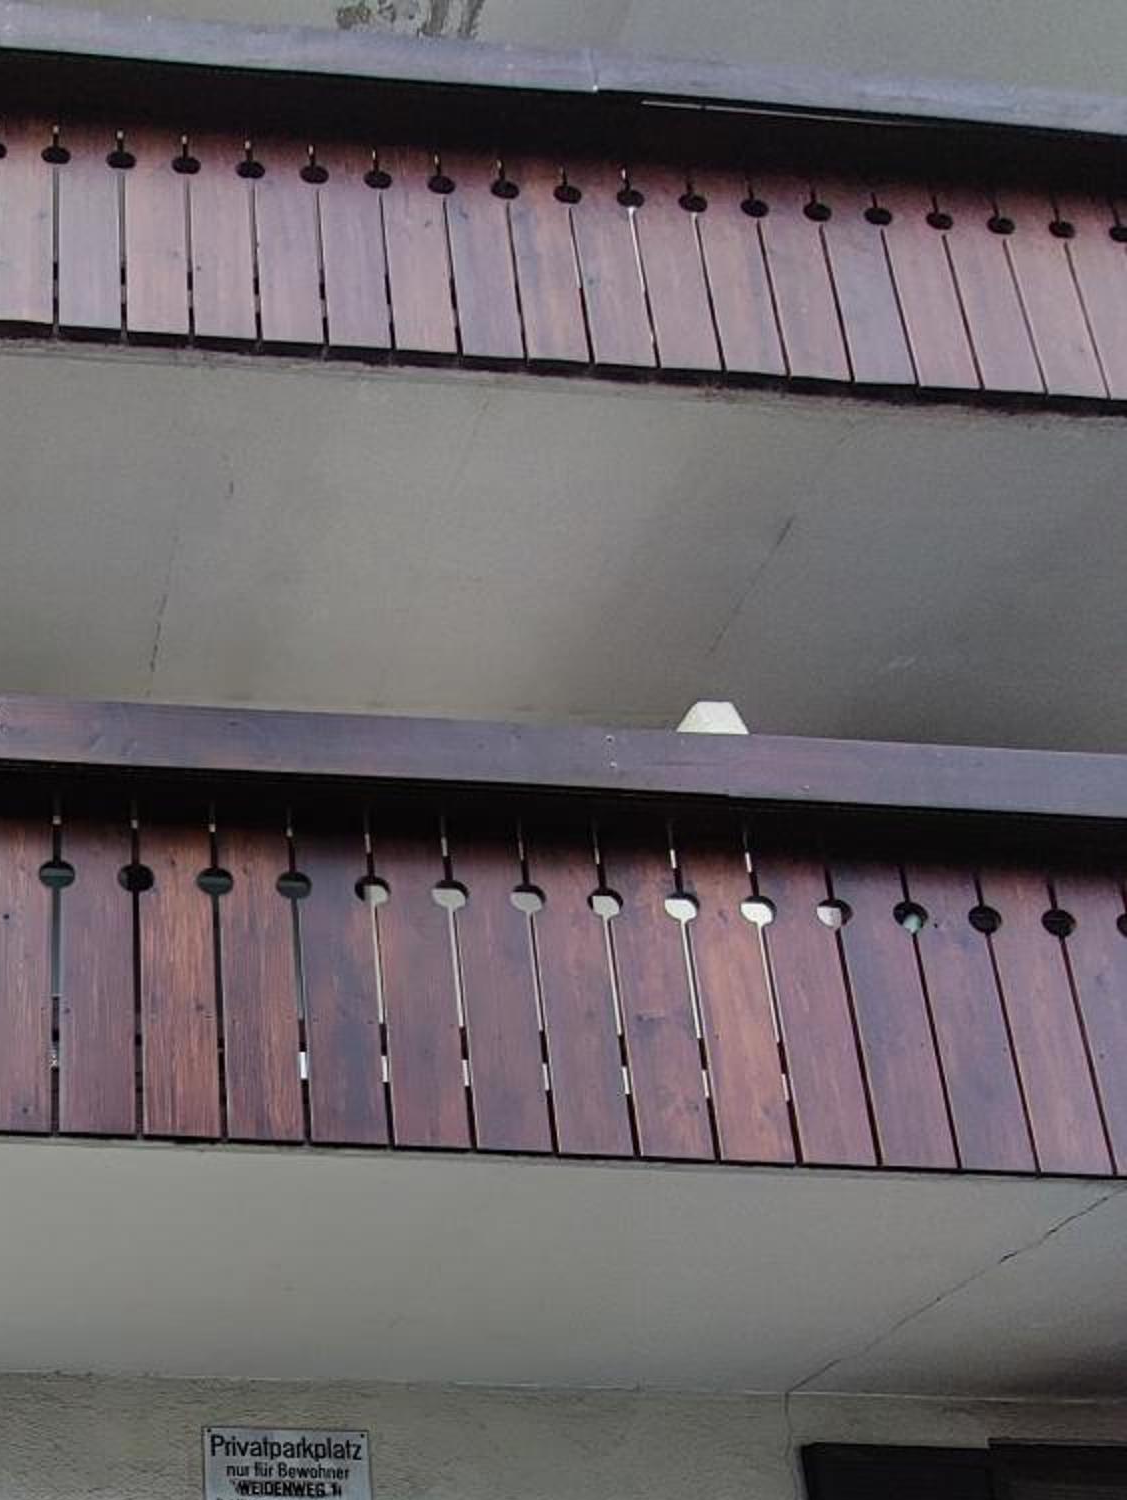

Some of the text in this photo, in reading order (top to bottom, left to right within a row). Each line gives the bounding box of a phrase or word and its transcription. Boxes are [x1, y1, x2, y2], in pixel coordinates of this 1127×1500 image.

[210, 1434, 362, 1461] Privatparkplatz
[226, 1462, 349, 1479] nur für Bewohner
